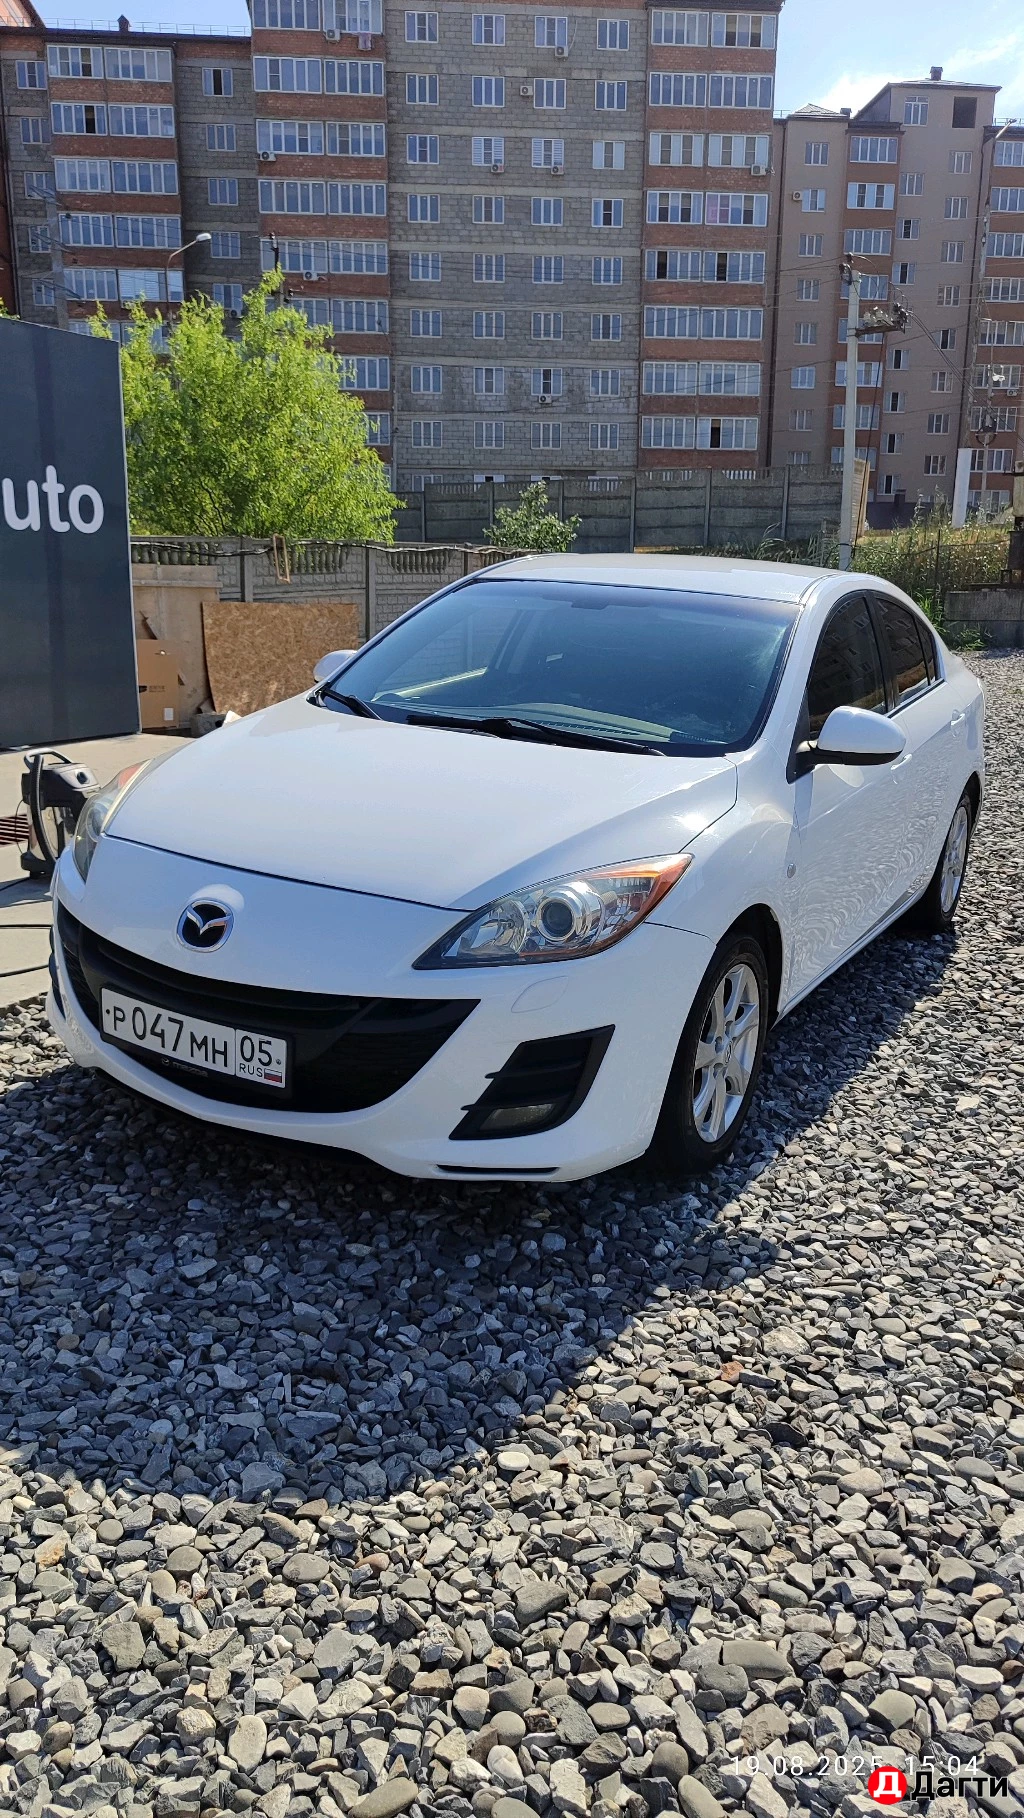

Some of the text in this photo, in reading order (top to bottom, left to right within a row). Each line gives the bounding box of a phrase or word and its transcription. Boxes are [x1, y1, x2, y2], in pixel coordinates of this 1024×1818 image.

[2, 464, 104, 534] uto
[240, 1035, 272, 1067] 05
[239, 1062, 263, 1078] RUS
